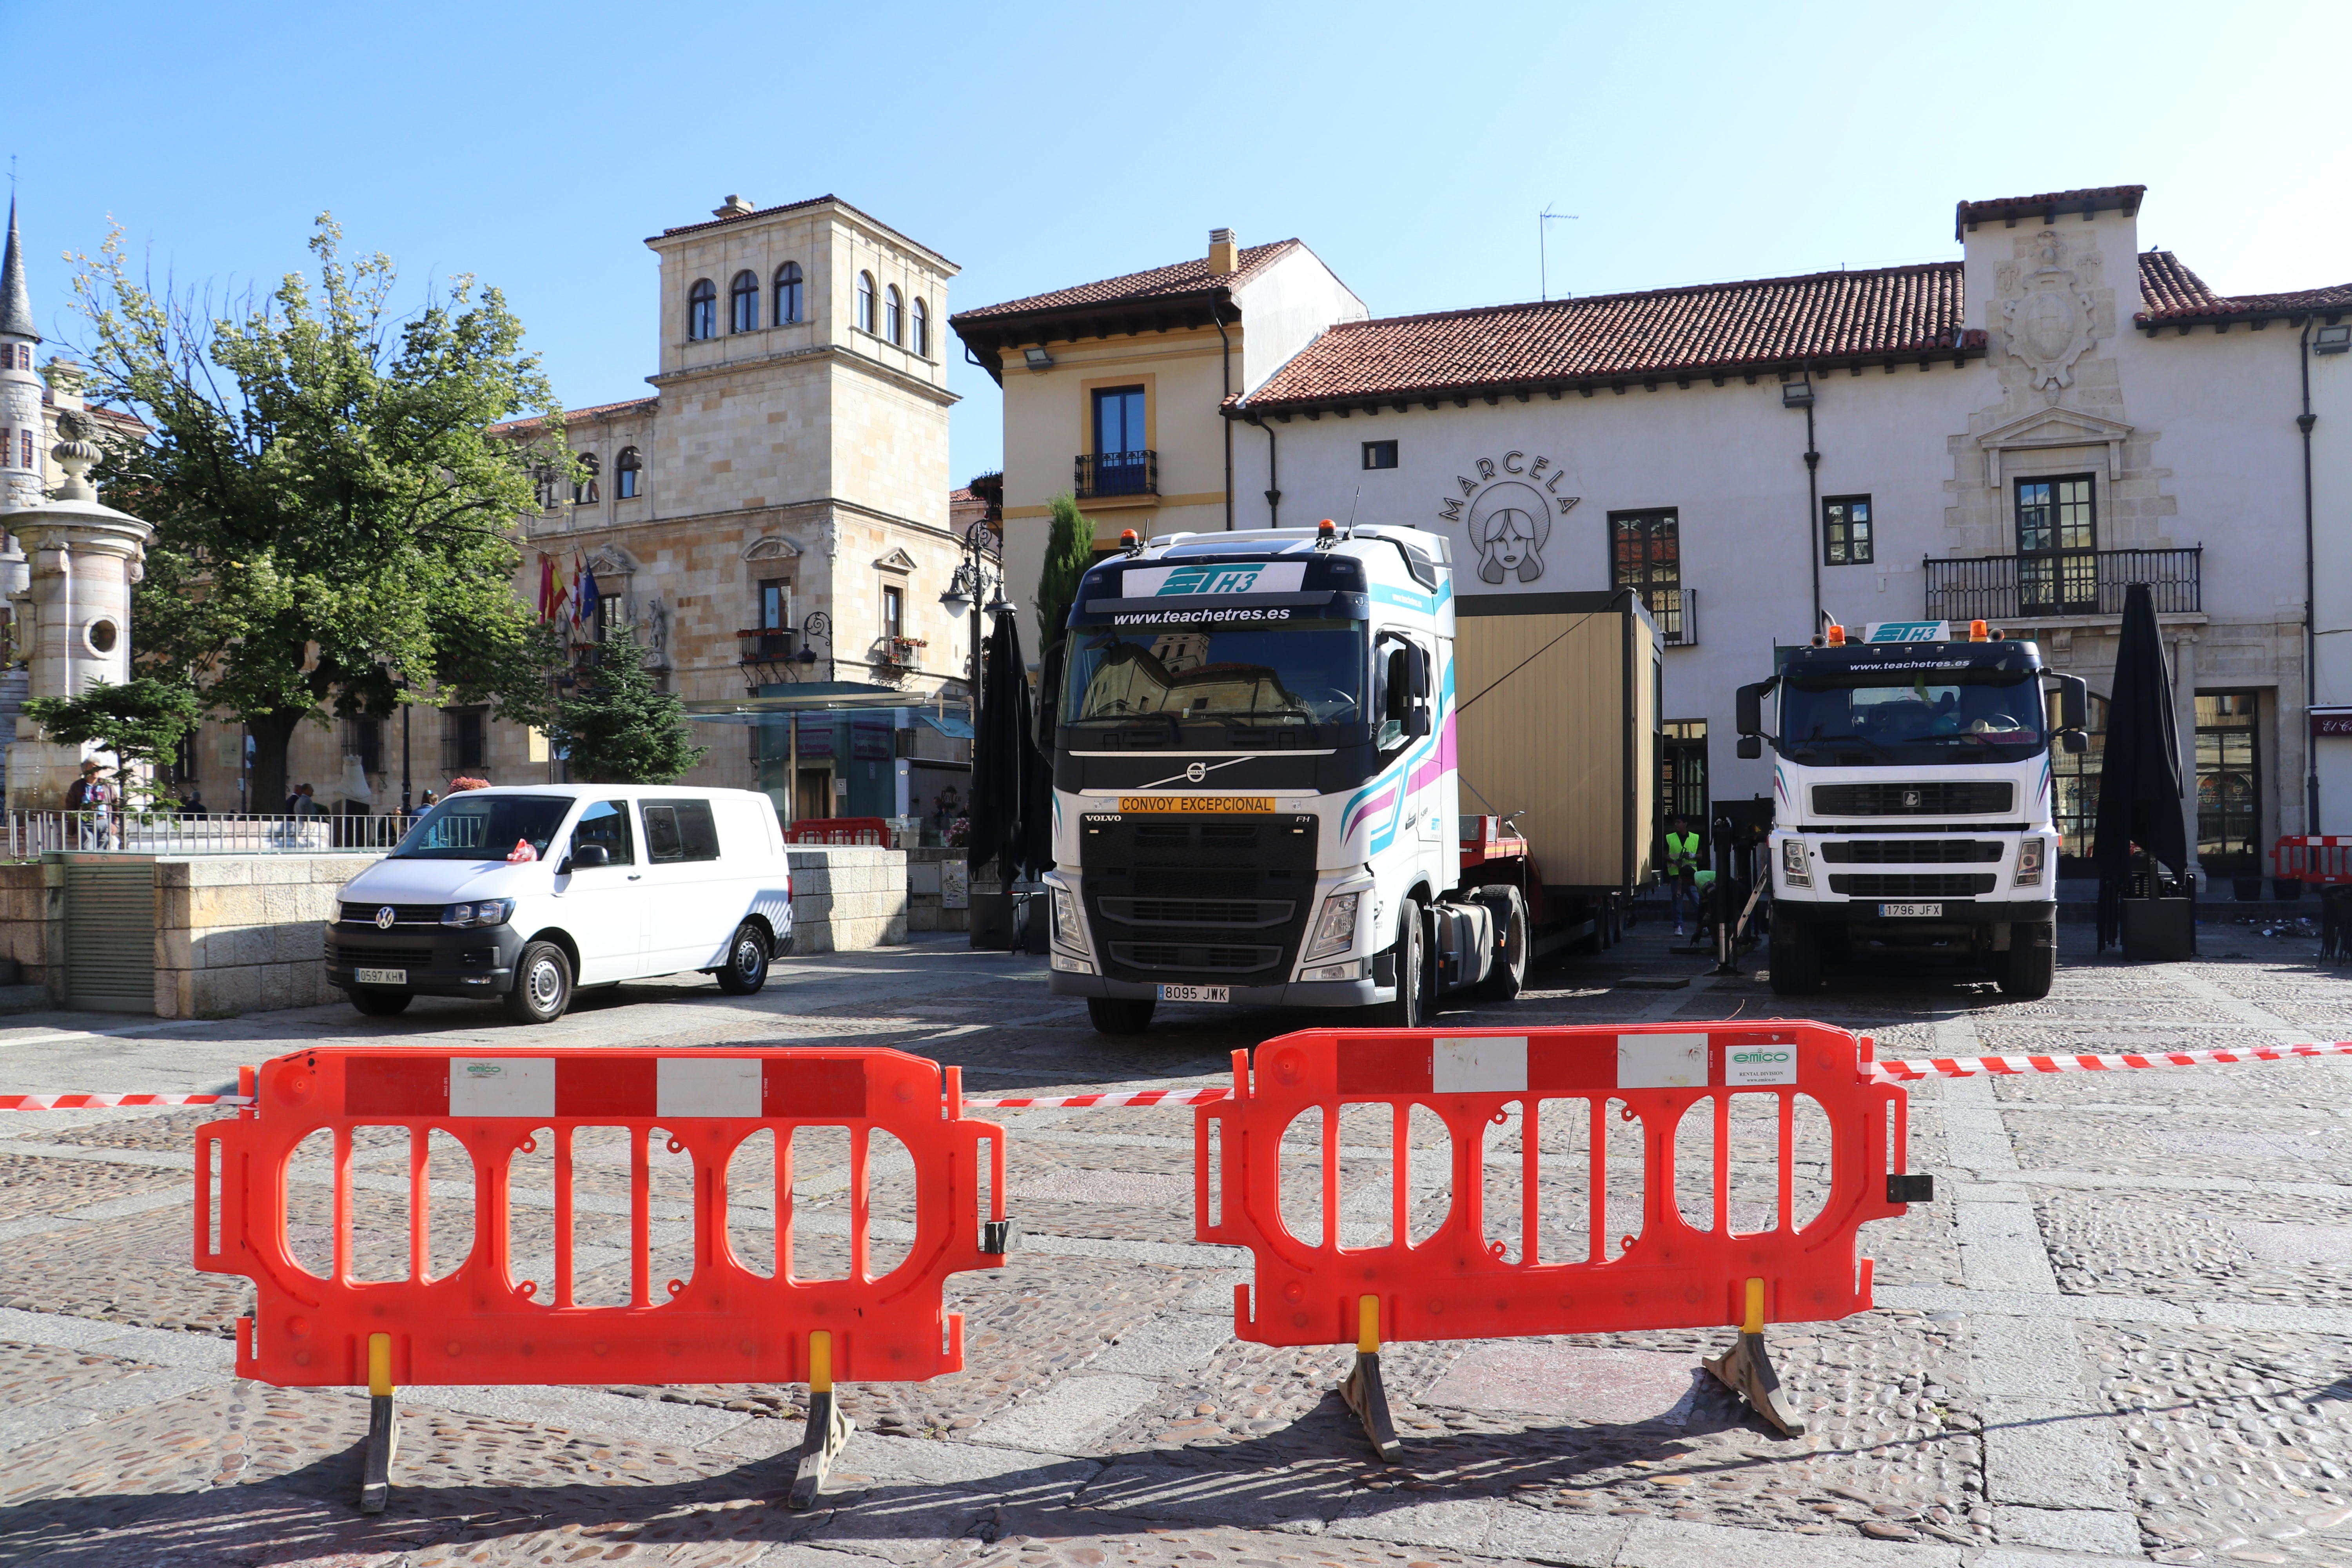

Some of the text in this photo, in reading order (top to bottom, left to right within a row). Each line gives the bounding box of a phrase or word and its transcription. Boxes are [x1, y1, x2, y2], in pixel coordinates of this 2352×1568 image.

[1439, 450, 1580, 521] MARCELA
[1114, 608, 1291, 625] www.teachetres.es
[1849, 659, 1970, 671] www.teachetres.es
[2322, 720, 2337, 732] El
[1122, 798, 1271, 811] CONVOY EXCEPCIONAL
[1887, 906, 1914, 915] 1796
[1919, 905, 1940, 915] JFX
[360, 971, 403, 982] 0597 KHW
[1165, 986, 1197, 999] 8095
[1203, 987, 1227, 1001] JWK
[1732, 1048, 1790, 1063] emico
